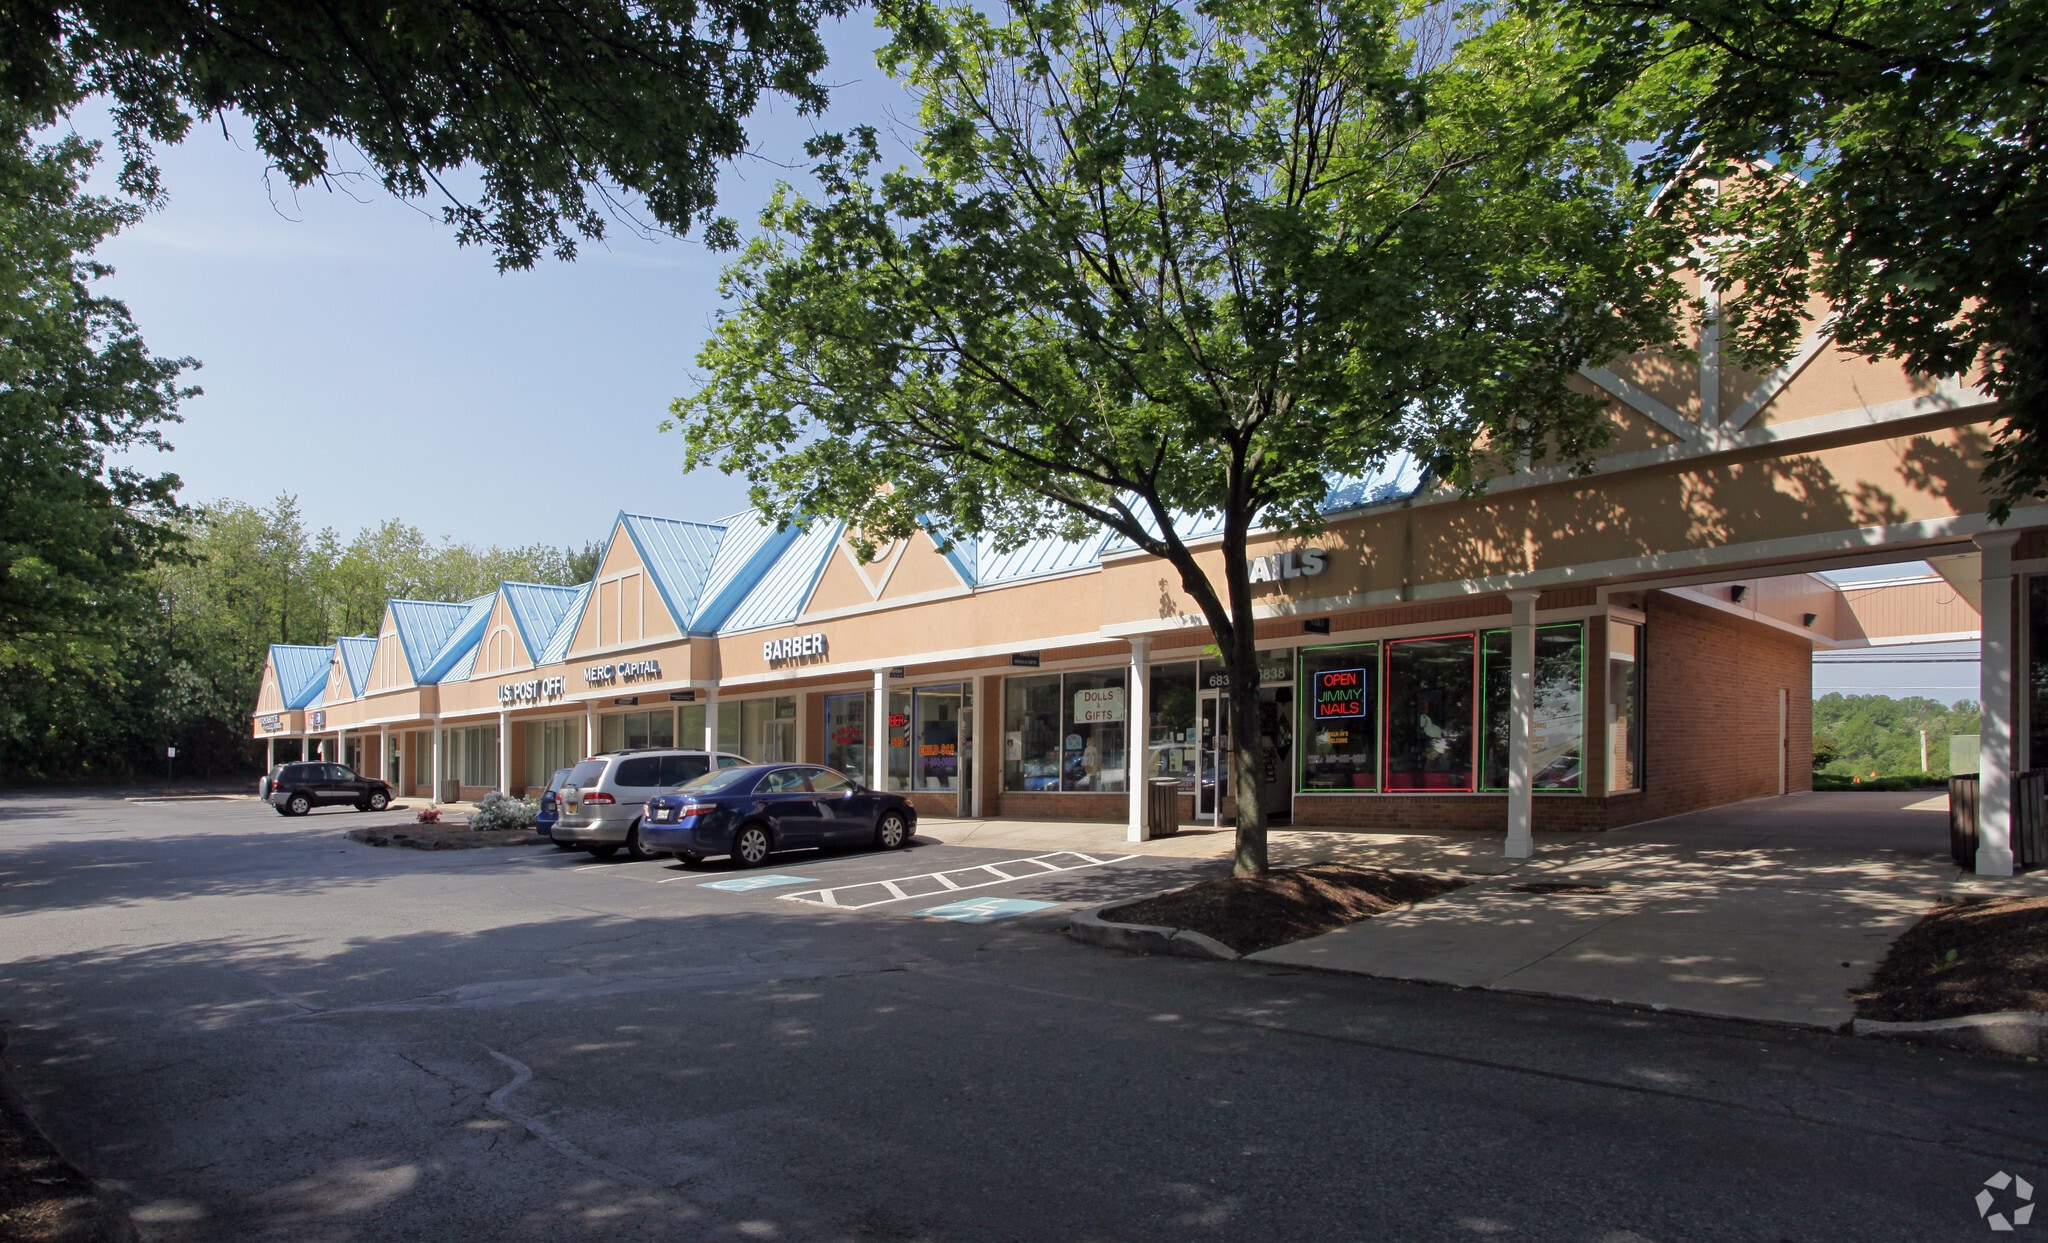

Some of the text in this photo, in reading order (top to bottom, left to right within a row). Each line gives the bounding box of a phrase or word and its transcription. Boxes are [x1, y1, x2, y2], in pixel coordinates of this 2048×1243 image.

[1247, 547, 1327, 584] AILS
[764, 633, 823, 661] BARBER
[584, 660, 657, 682] MERC CAPITAL
[1209, 674, 1230, 687] 683
[1323, 673, 1357, 687] OPEN
[497, 684, 512, 702] U.S.
[514, 680, 538, 698] POST
[1084, 691, 1114, 702] DOLLS
[1317, 688, 1363, 702] JIMMY
[1085, 710, 1113, 721] GIFTS
[1320, 702, 1360, 716] NAILS
